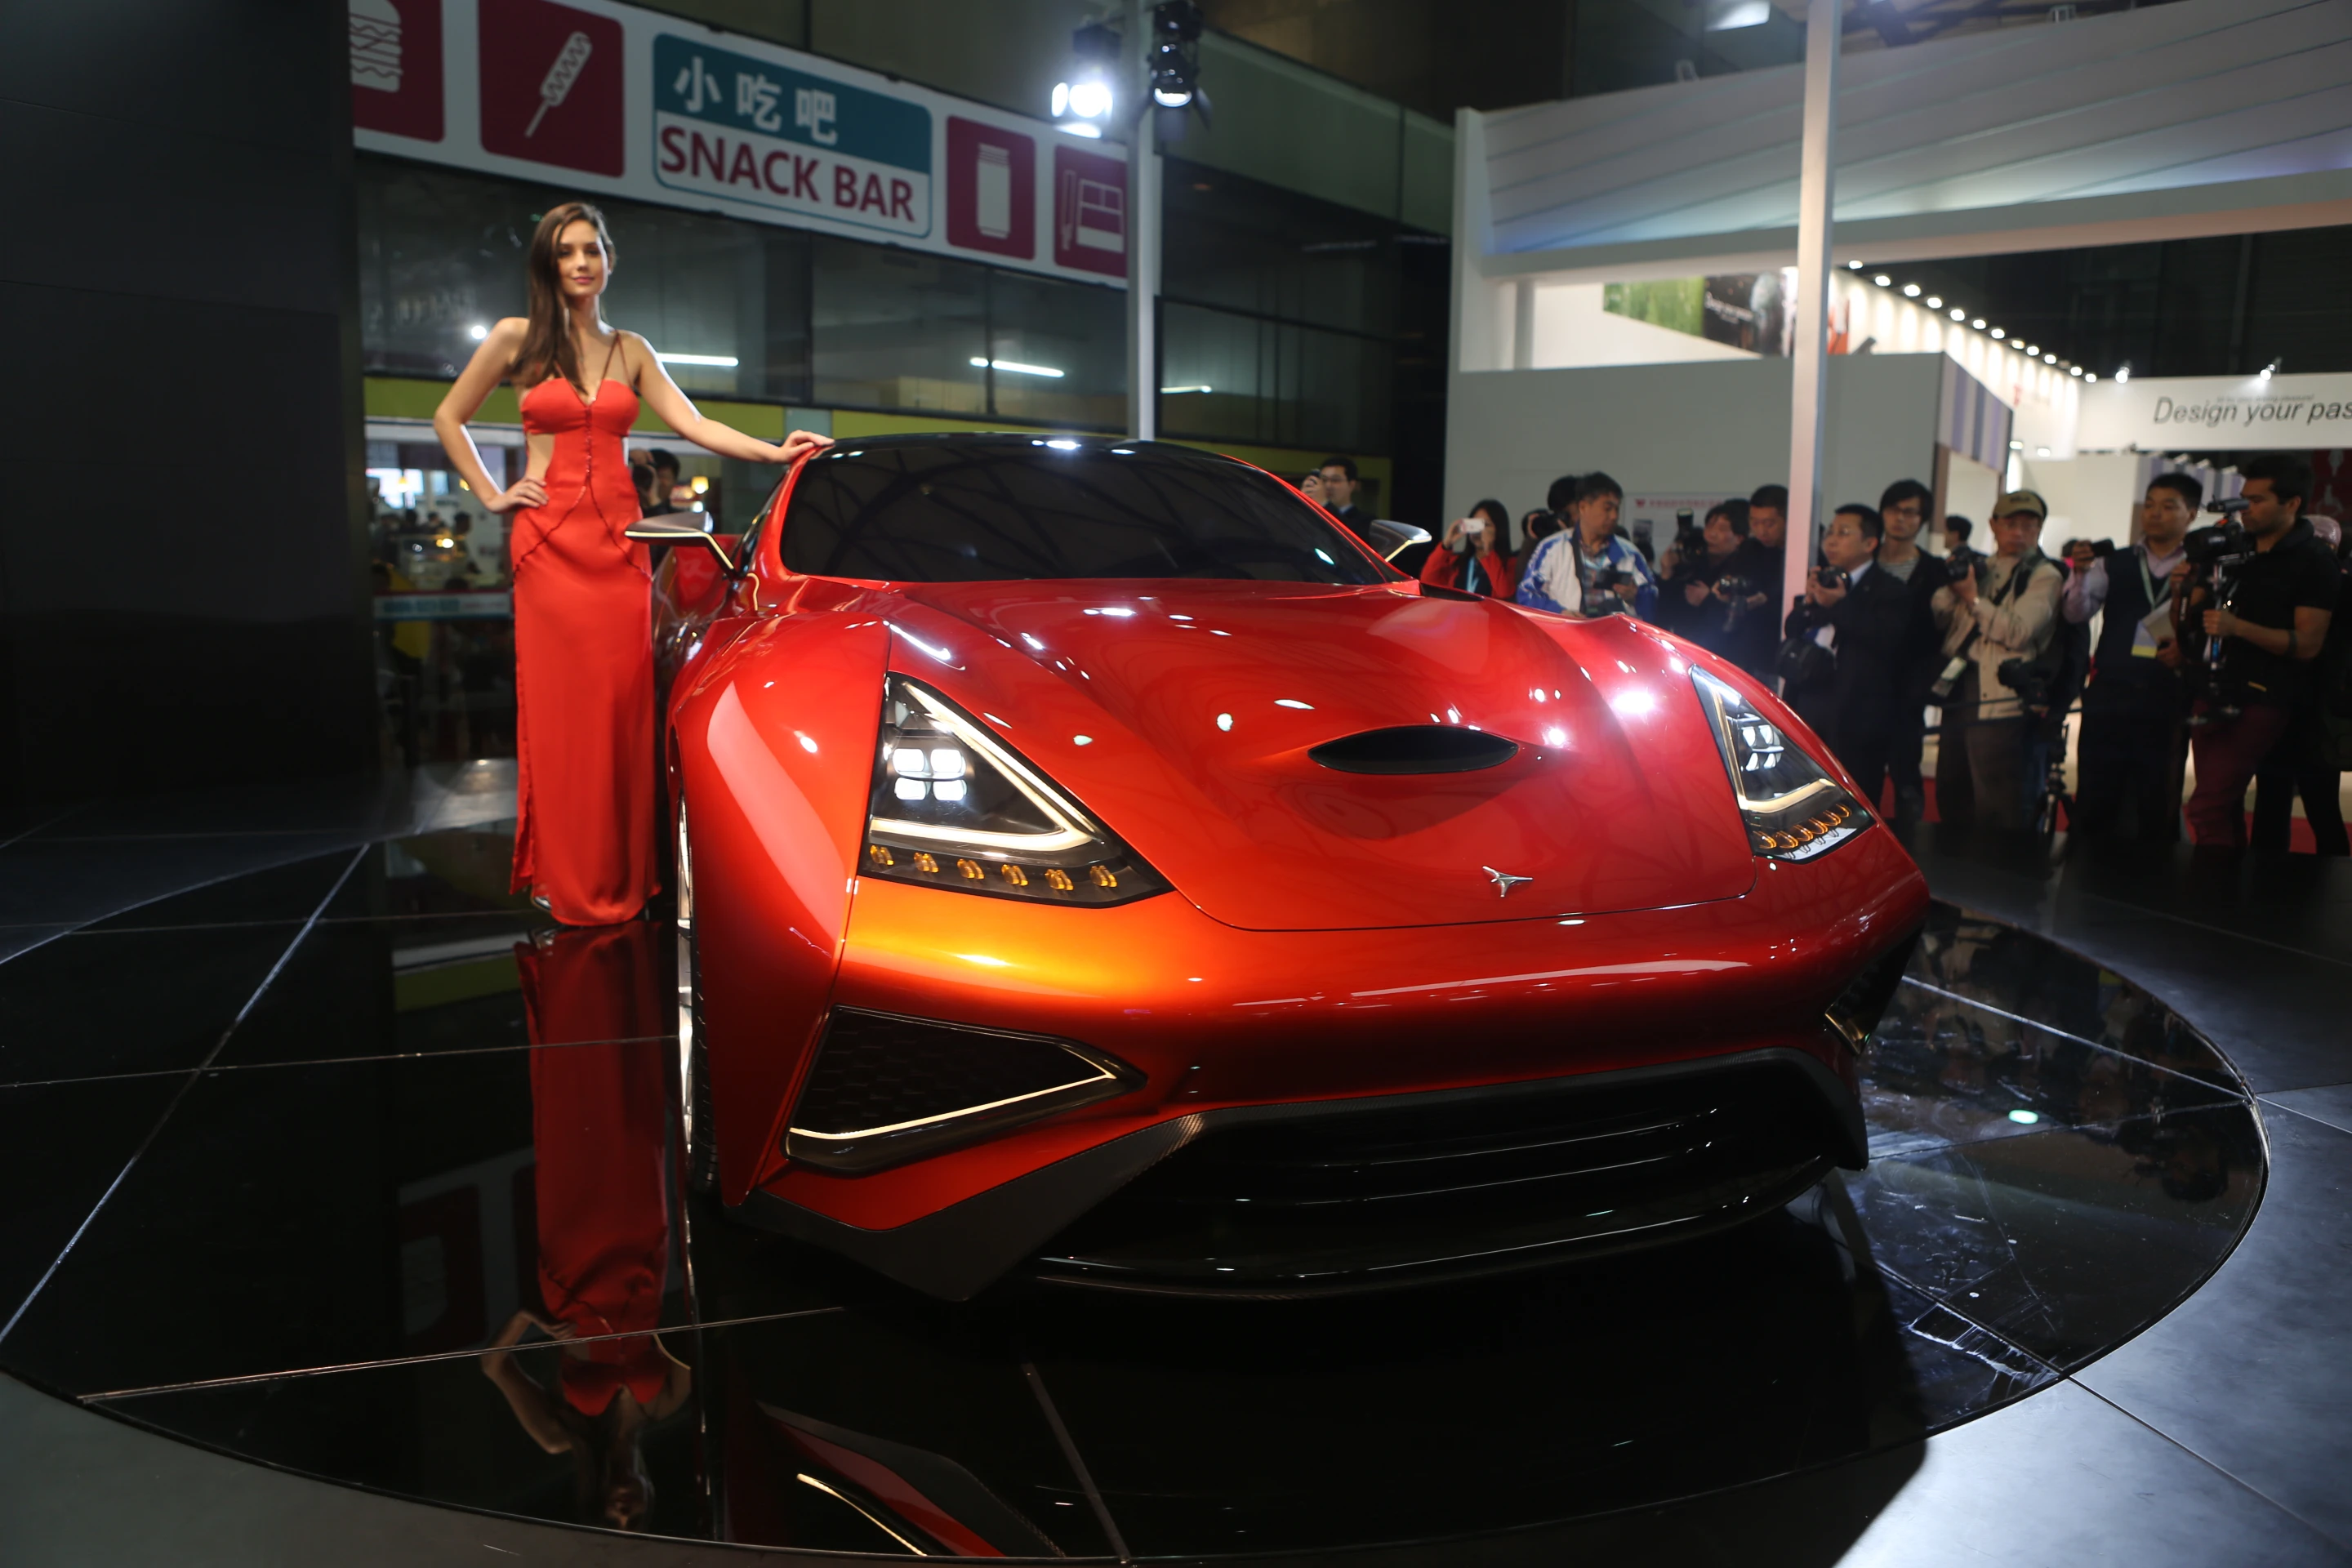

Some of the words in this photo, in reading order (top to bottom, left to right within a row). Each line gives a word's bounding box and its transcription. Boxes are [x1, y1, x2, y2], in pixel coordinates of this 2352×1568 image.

[674, 56, 837, 145] 小吃吧
[660, 125, 820, 202] SNACK
[834, 165, 915, 222] BAR
[2154, 396, 2238, 427] Design
[2243, 402, 2304, 427] your
